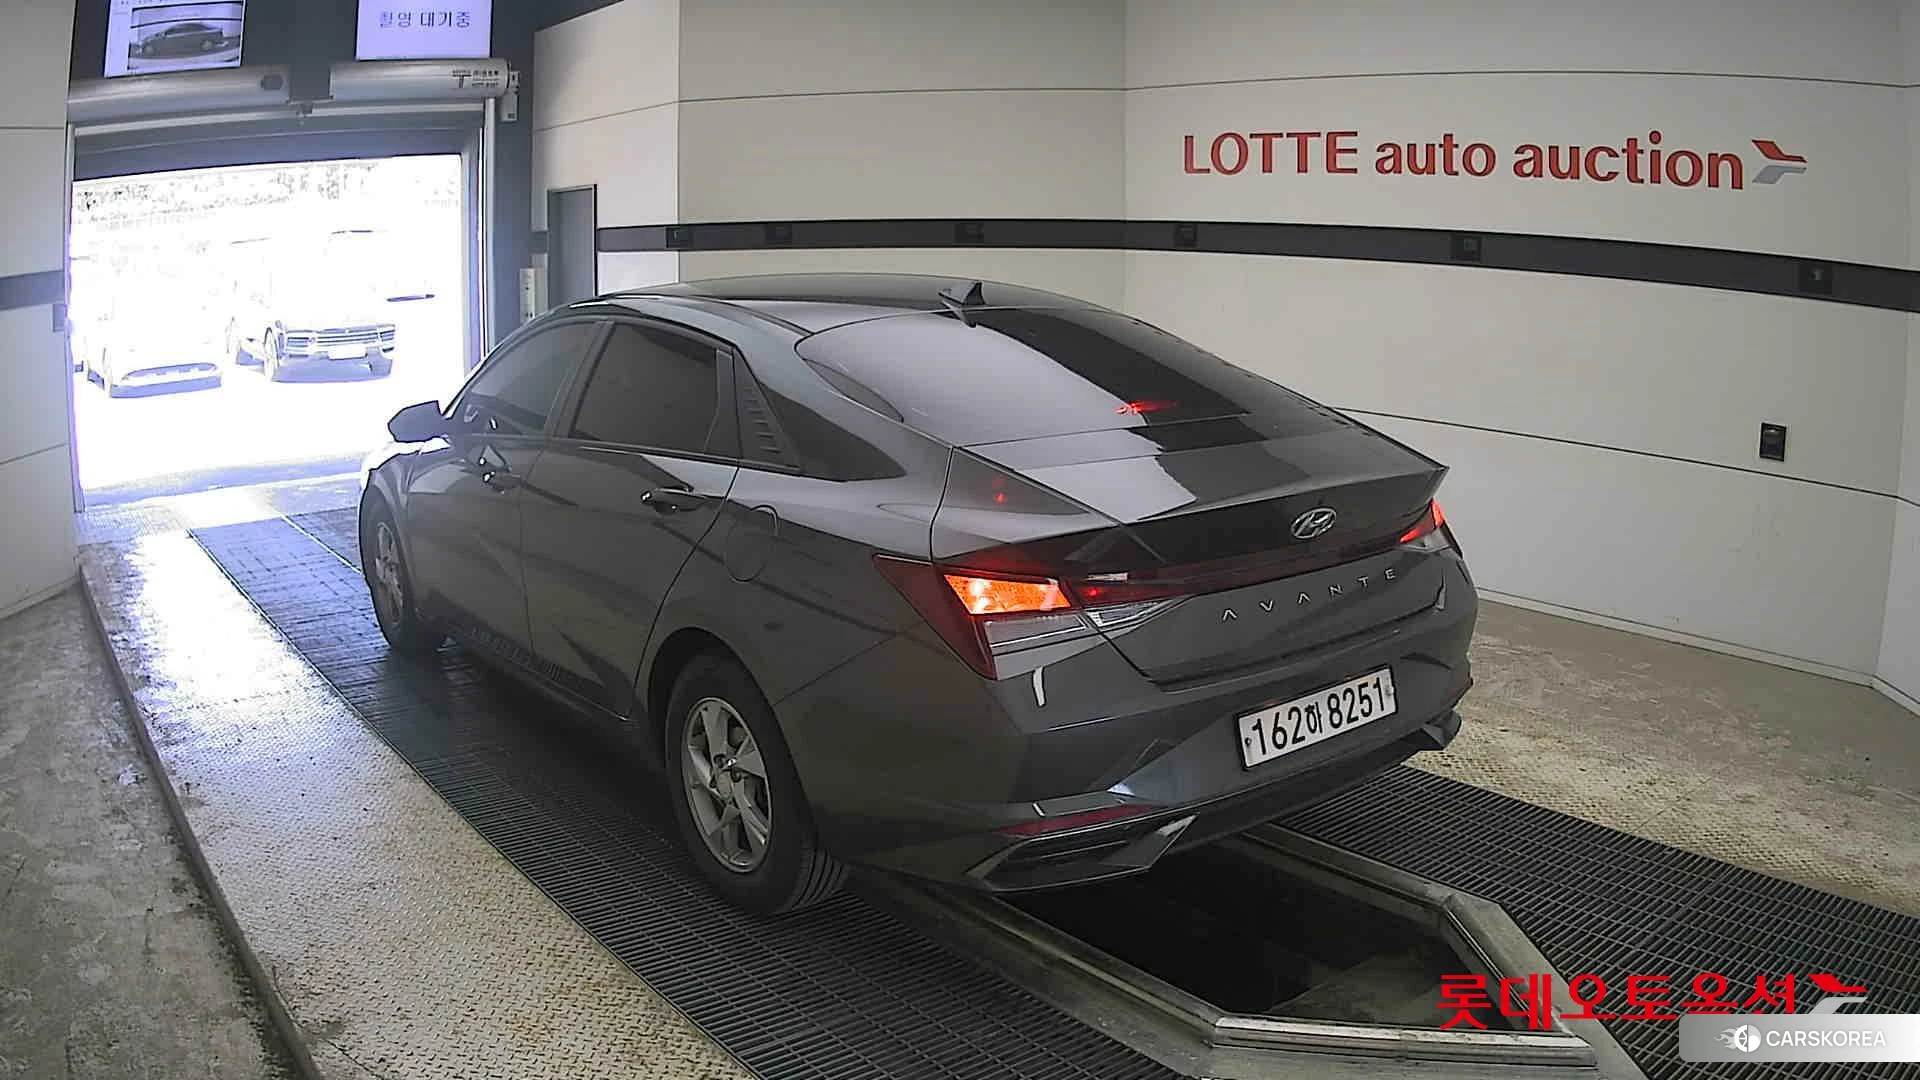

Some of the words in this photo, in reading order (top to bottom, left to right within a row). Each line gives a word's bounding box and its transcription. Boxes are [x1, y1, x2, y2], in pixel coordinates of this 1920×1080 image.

[419, 10, 471, 29] 대기중
[1183, 130, 1358, 175] LOTTE
[1375, 133, 1497, 177] auto
[1512, 130, 1744, 190] auction
[1221, 567, 1397, 624] AVANTE
